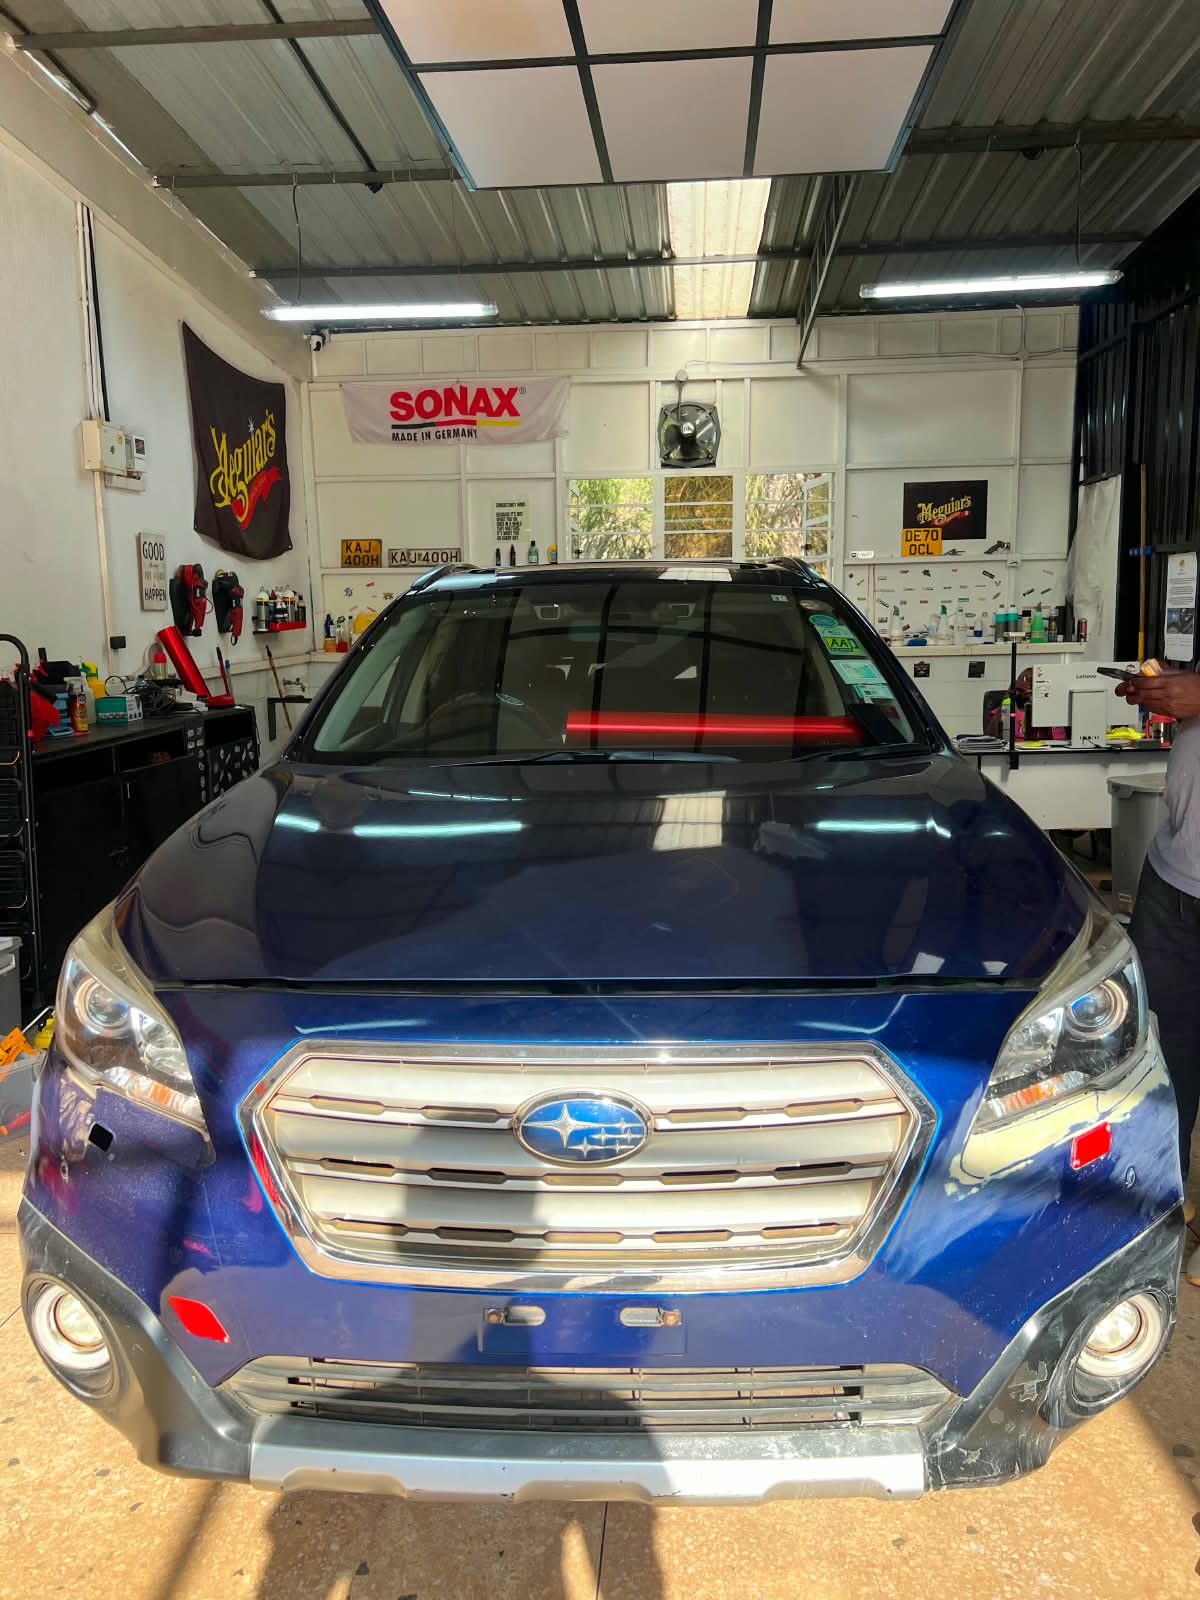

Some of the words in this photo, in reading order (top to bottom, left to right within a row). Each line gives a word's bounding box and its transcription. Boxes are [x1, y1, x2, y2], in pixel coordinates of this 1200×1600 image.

[389, 385, 521, 422] SONAX
[391, 431, 418, 442] MADE
[421, 430, 432, 441] IN
[434, 428, 478, 441] GERMANY
[905, 529, 939, 541] DE70
[142, 541, 165, 561] GOOD
[345, 541, 372, 554] KAJ
[909, 543, 934, 556] OCL
[344, 554, 379, 566] 400H
[391, 551, 417, 564] KAJ
[422, 551, 459, 563] 400H
[144, 587, 167, 601] HAPPEN
